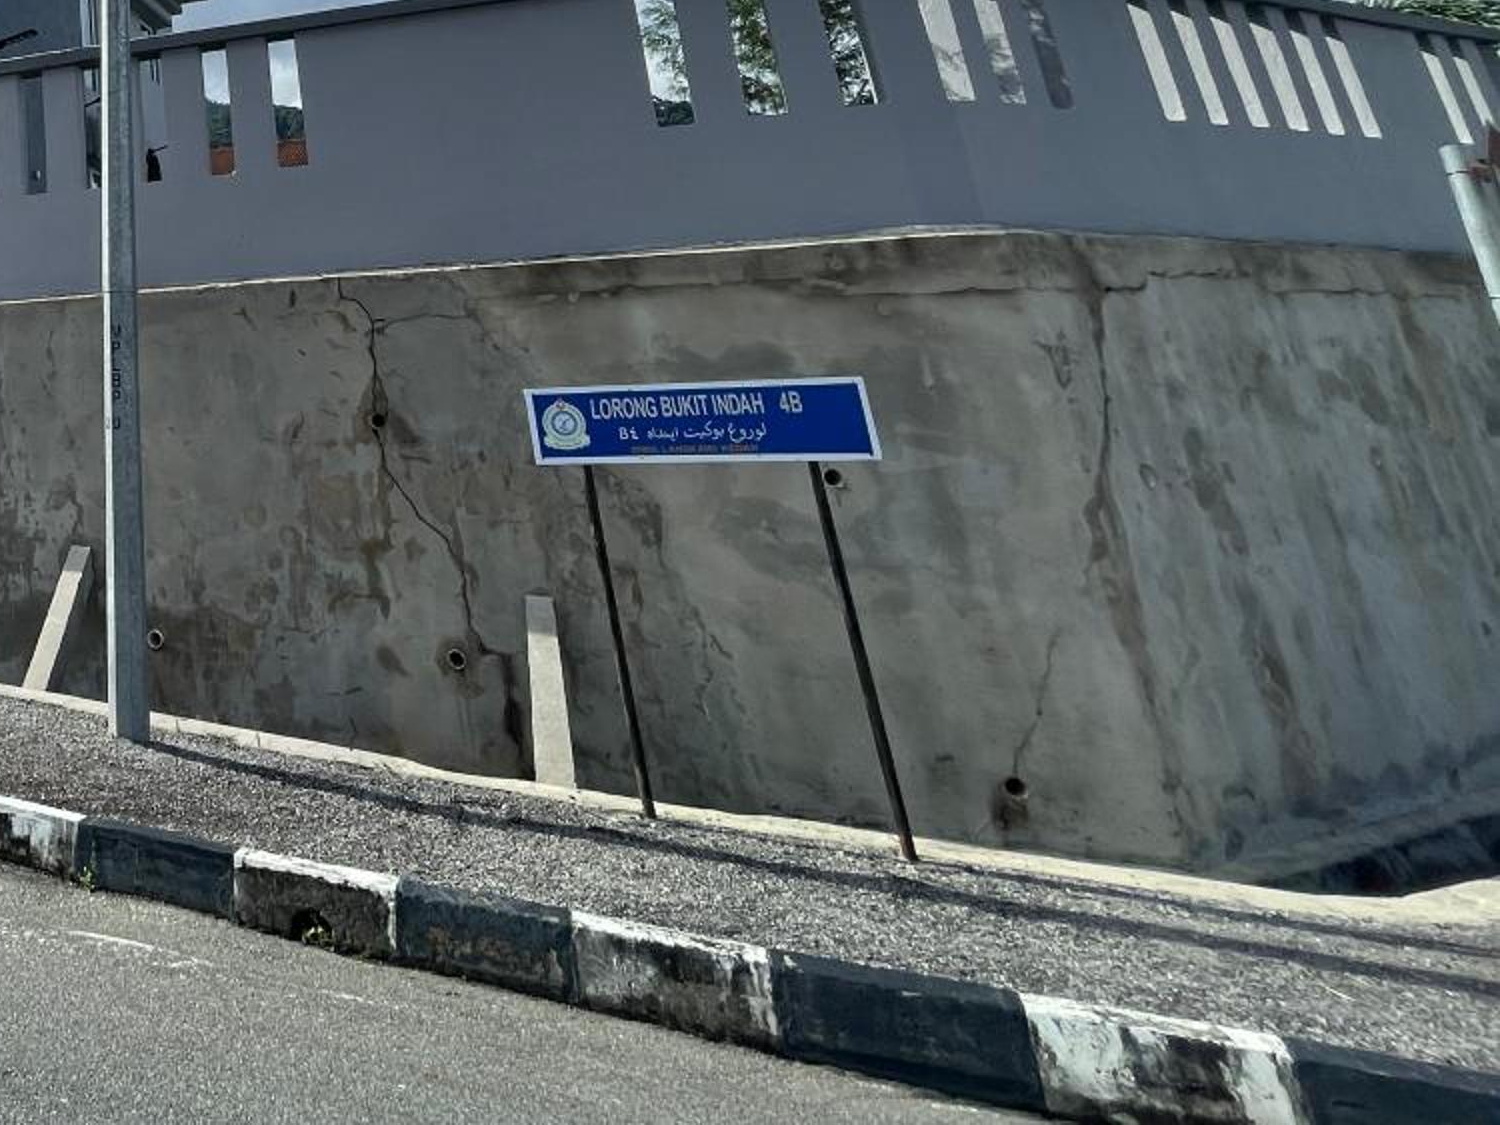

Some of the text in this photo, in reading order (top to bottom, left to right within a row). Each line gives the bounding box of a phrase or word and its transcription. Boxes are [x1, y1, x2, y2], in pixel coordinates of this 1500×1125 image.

[590, 390, 803, 419] LORONG BUKIT INDAH 4B
